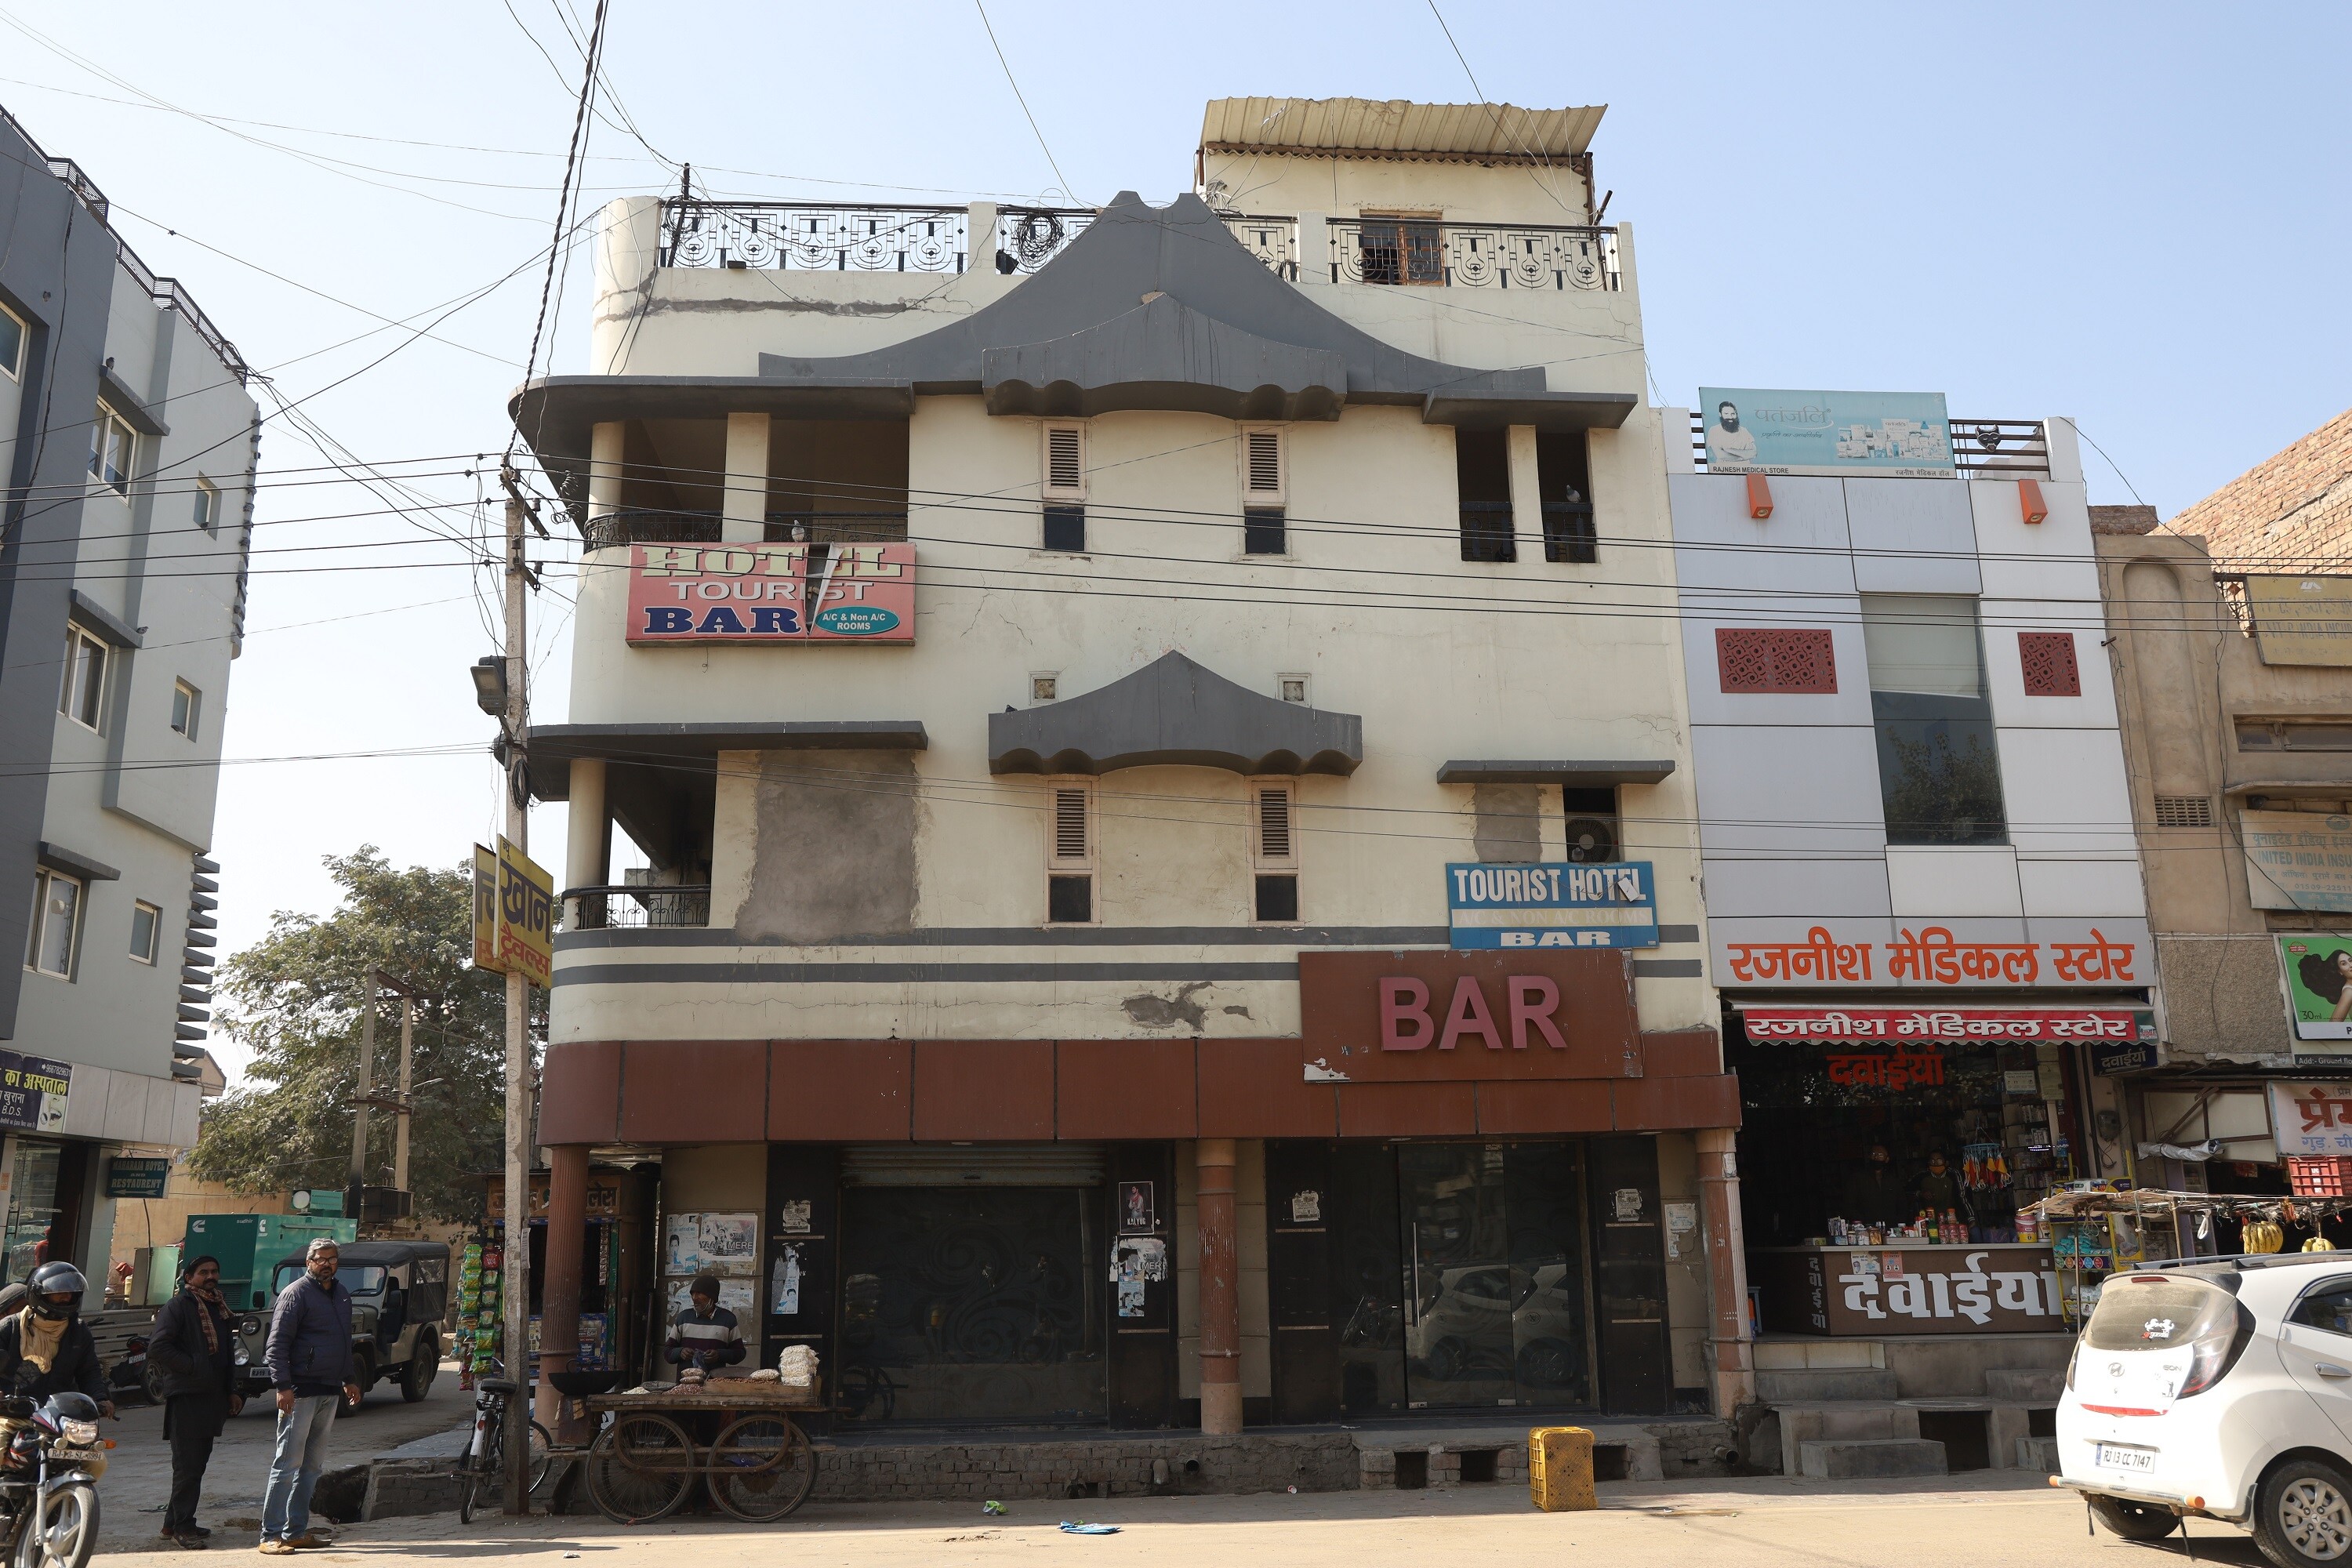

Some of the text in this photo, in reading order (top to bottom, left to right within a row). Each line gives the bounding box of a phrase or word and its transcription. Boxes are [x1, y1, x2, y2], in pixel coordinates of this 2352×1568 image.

[1755, 406, 1827, 423] पतंजलि
[643, 606, 801, 634] BAR
[837, 622, 871, 630] ROOMS
[2295, 851, 2325, 867] INDIA
[1454, 869, 1561, 902] TOURIST
[1459, 910, 1487, 925] A/C
[1510, 910, 1548, 925] NON
[1554, 910, 1582, 924] A/C
[1585, 909, 1646, 924] ROOMS
[1500, 931, 1611, 947] BAR
[1727, 926, 2135, 985] रजनीश मेडिकल स्टोर
[1380, 975, 1568, 1051] BAR
[1747, 1012, 1888, 1036] रजनीश
[1895, 1012, 2044, 1036] मेडिकल
[2049, 1013, 2129, 1037] स्टोर
[2100, 1047, 2146, 1067] दवाईयां
[1826, 1043, 1944, 1091] दवाईयां
[5, 1069, 68, 1095] का अस्पताल
[3, 1091, 26, 1106] खुराना
[2, 1105, 22, 1116] B.D.S.
[112, 1160, 165, 1171] MAHARAJA HOTEL
[111, 1178, 162, 1189] RESTAURENT
[728, 1241, 753, 1250] MERE
[1838, 1251, 2063, 1326] दवाईयां
[2103, 1450, 2151, 1468] RJ 13 CC 7147
